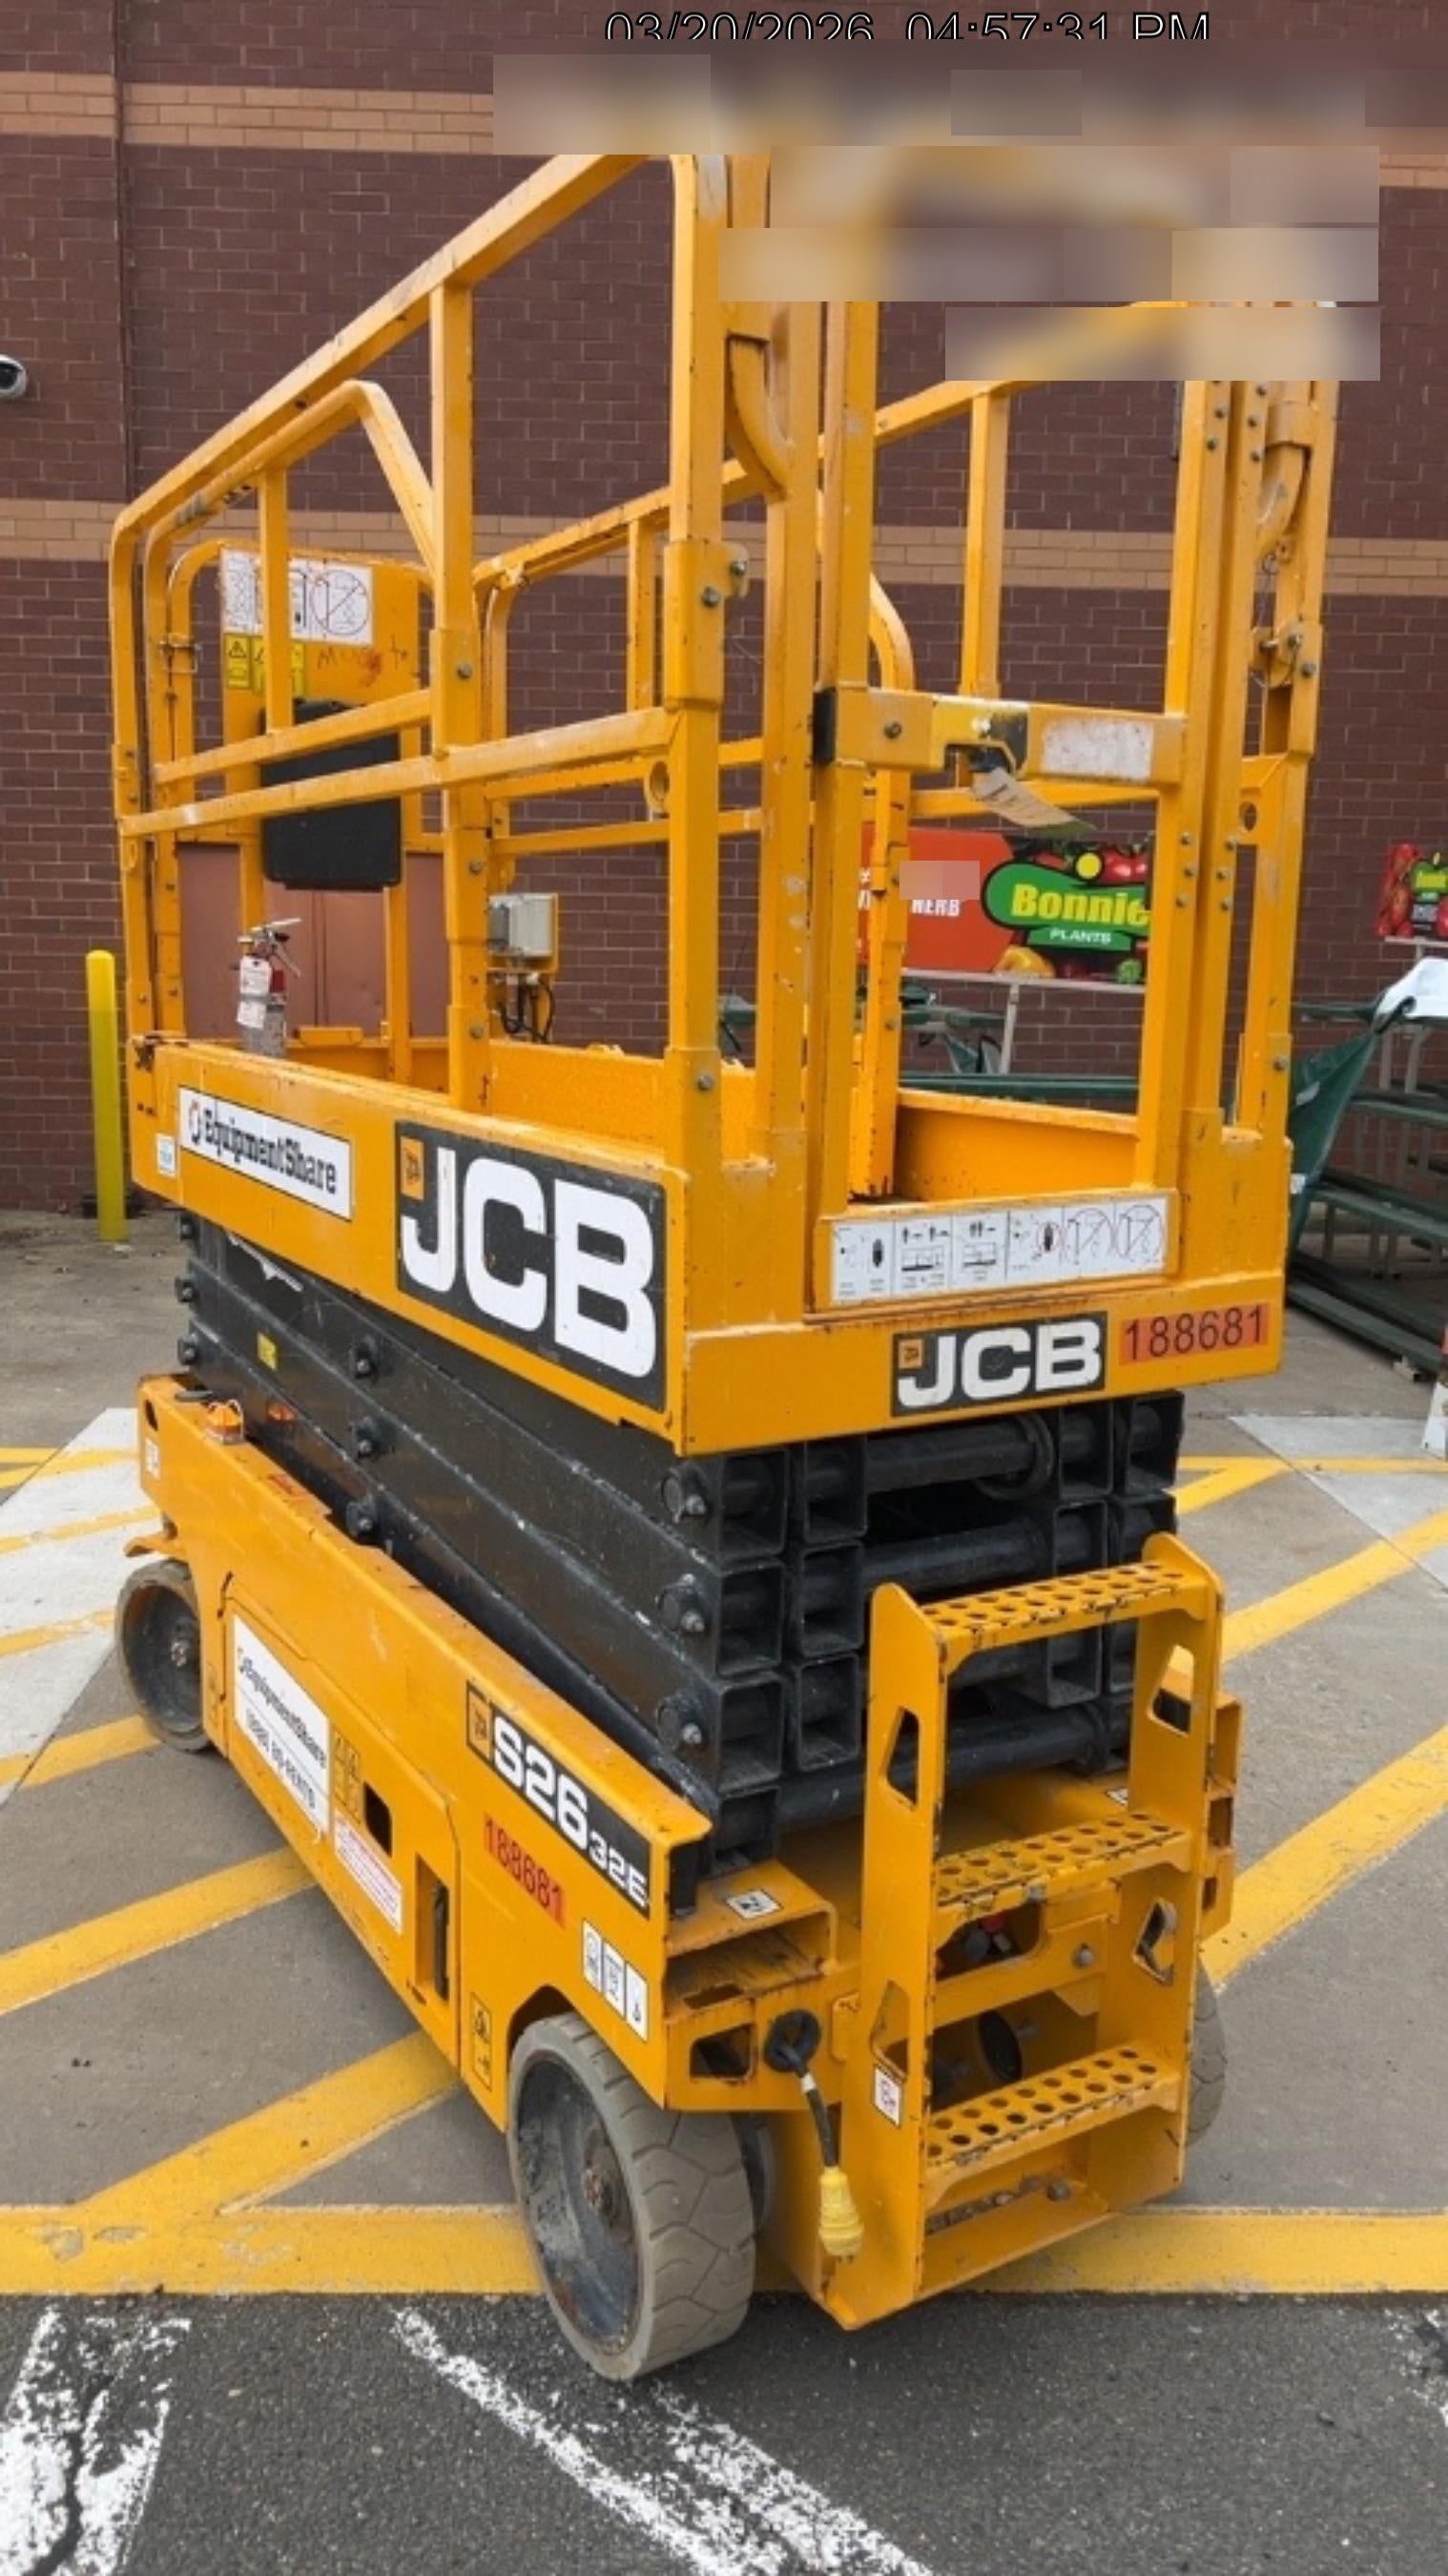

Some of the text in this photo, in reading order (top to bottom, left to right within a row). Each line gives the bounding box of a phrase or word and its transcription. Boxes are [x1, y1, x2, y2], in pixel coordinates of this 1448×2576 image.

[1011, 883, 1149, 925] Bonnie
[1049, 927, 1111, 945] PLANTS
[401, 1147, 656, 1378] JCB
[898, 1319, 1100, 1407] JCB
[1125, 1305, 1267, 1361] 188681
[485, 1816, 562, 1919] 188681
